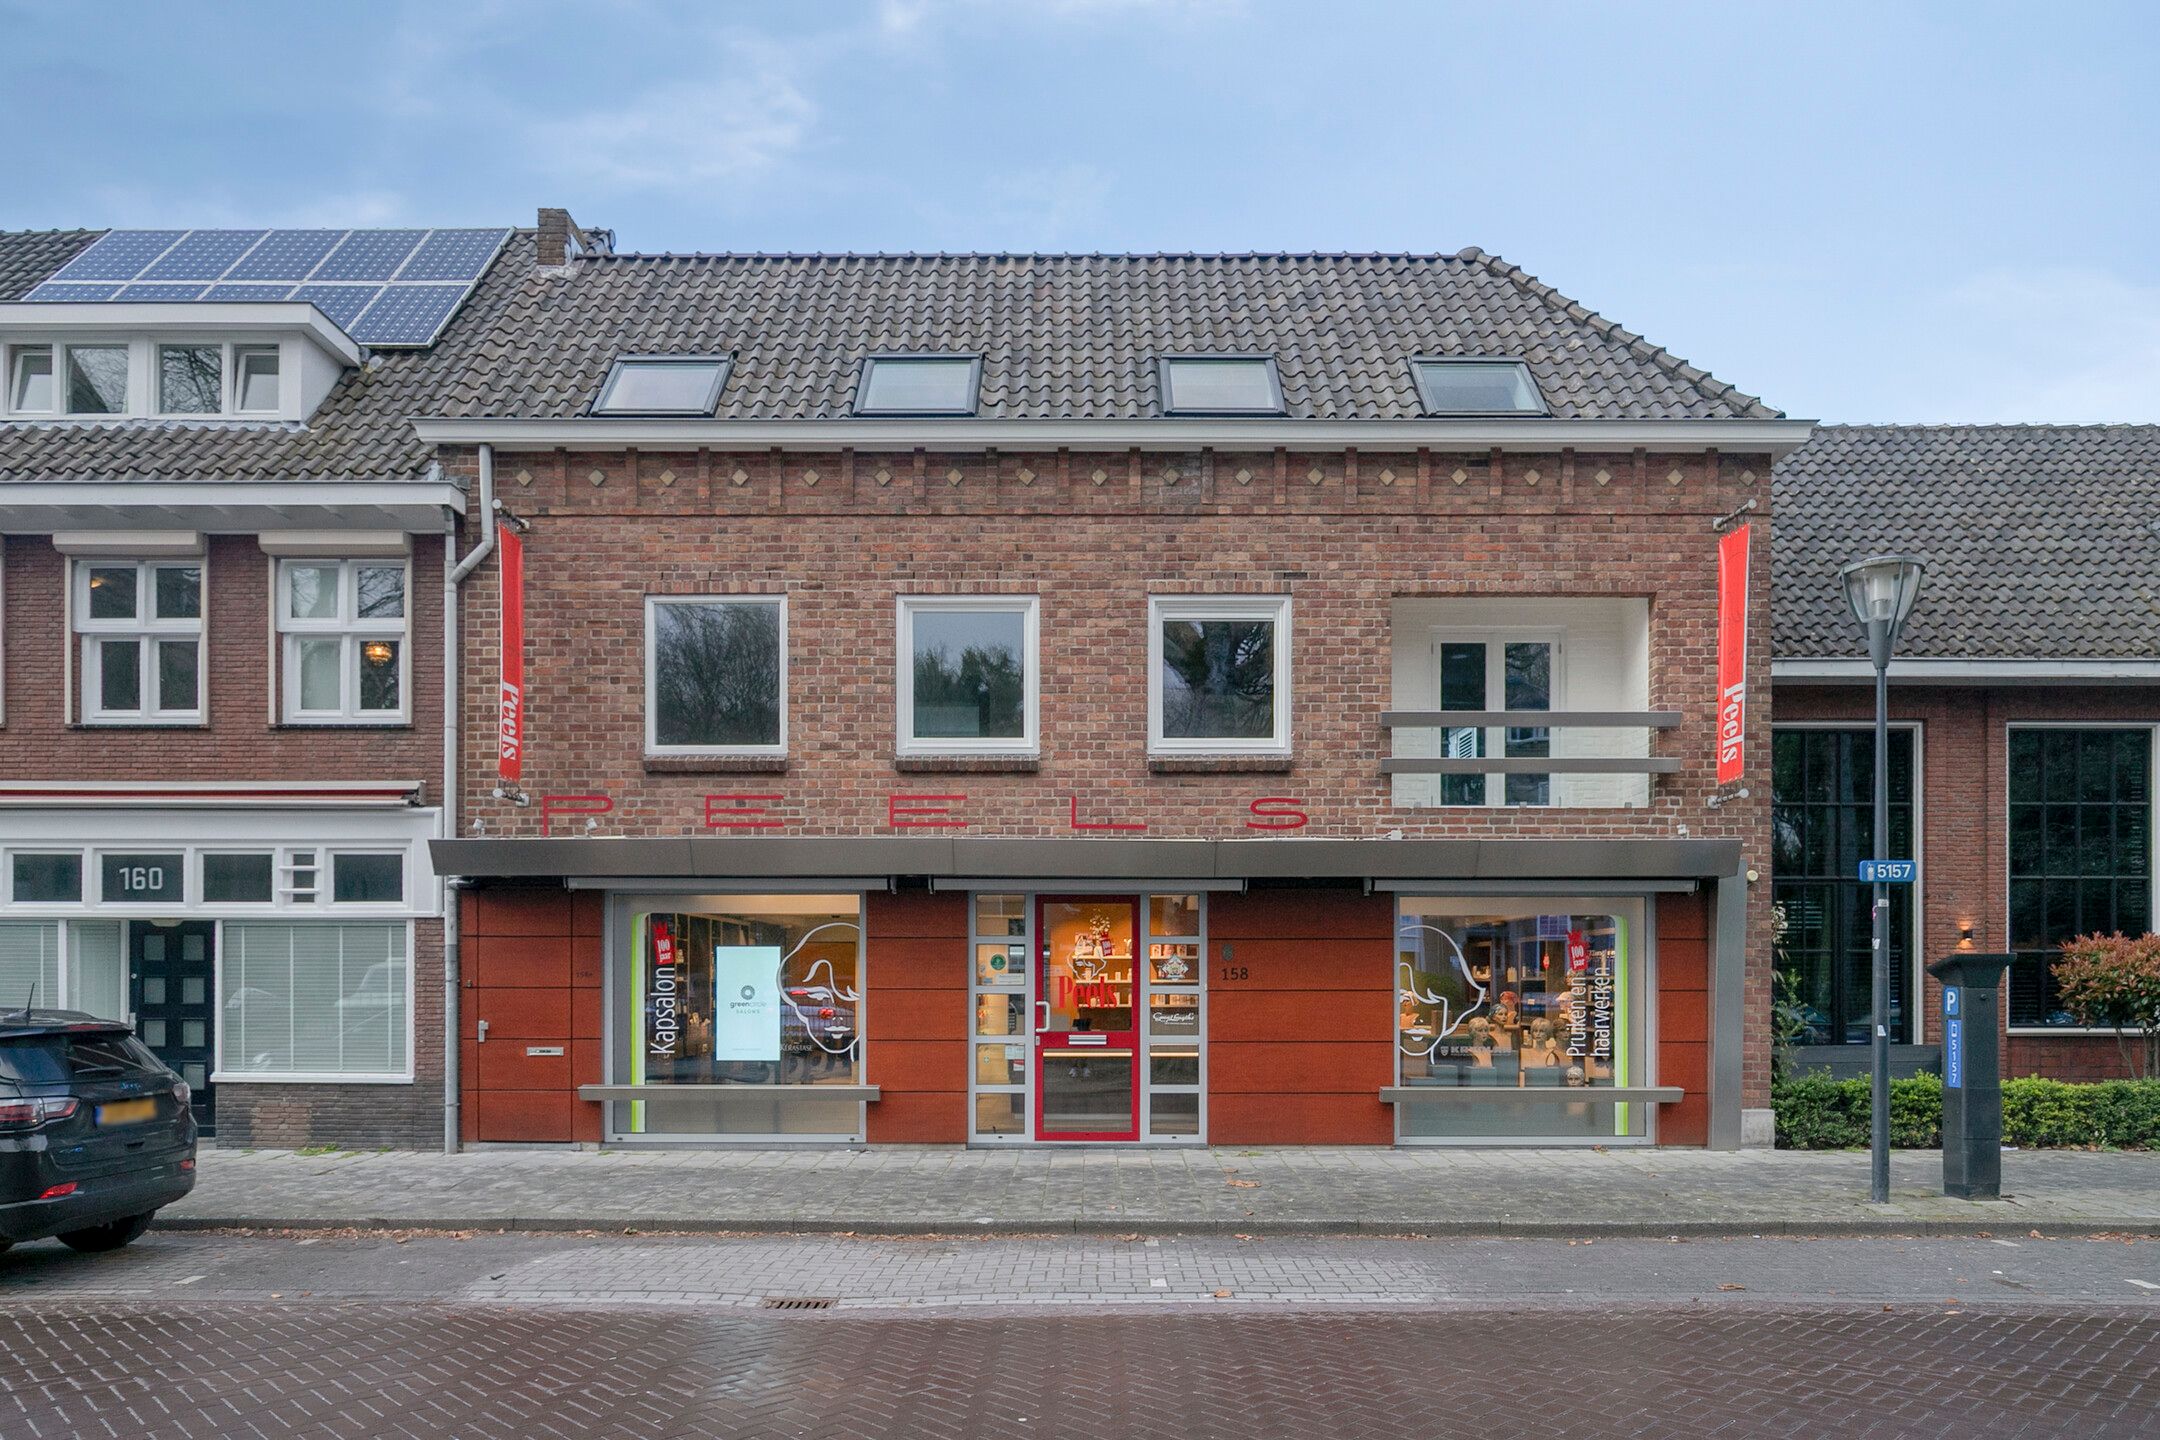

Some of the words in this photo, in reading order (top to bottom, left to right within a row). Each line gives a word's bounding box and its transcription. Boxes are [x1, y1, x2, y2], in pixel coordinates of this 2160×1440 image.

[1722, 682, 1745, 764] Peels
[543, 794, 1308, 837] PEELS
[119, 867, 164, 891] 160
[1876, 863, 1912, 879] 5157
[1058, 975, 1118, 1009] Peels
[1221, 966, 1249, 981] 158
[1570, 976, 1586, 996] en
[650, 967, 679, 1054] Kapsalon
[1590, 966, 1610, 1057] haarwerken
[1946, 991, 1957, 1012] P
[1566, 1000, 1586, 1057] Pruiken
[1950, 1039, 1958, 1084] 5157
